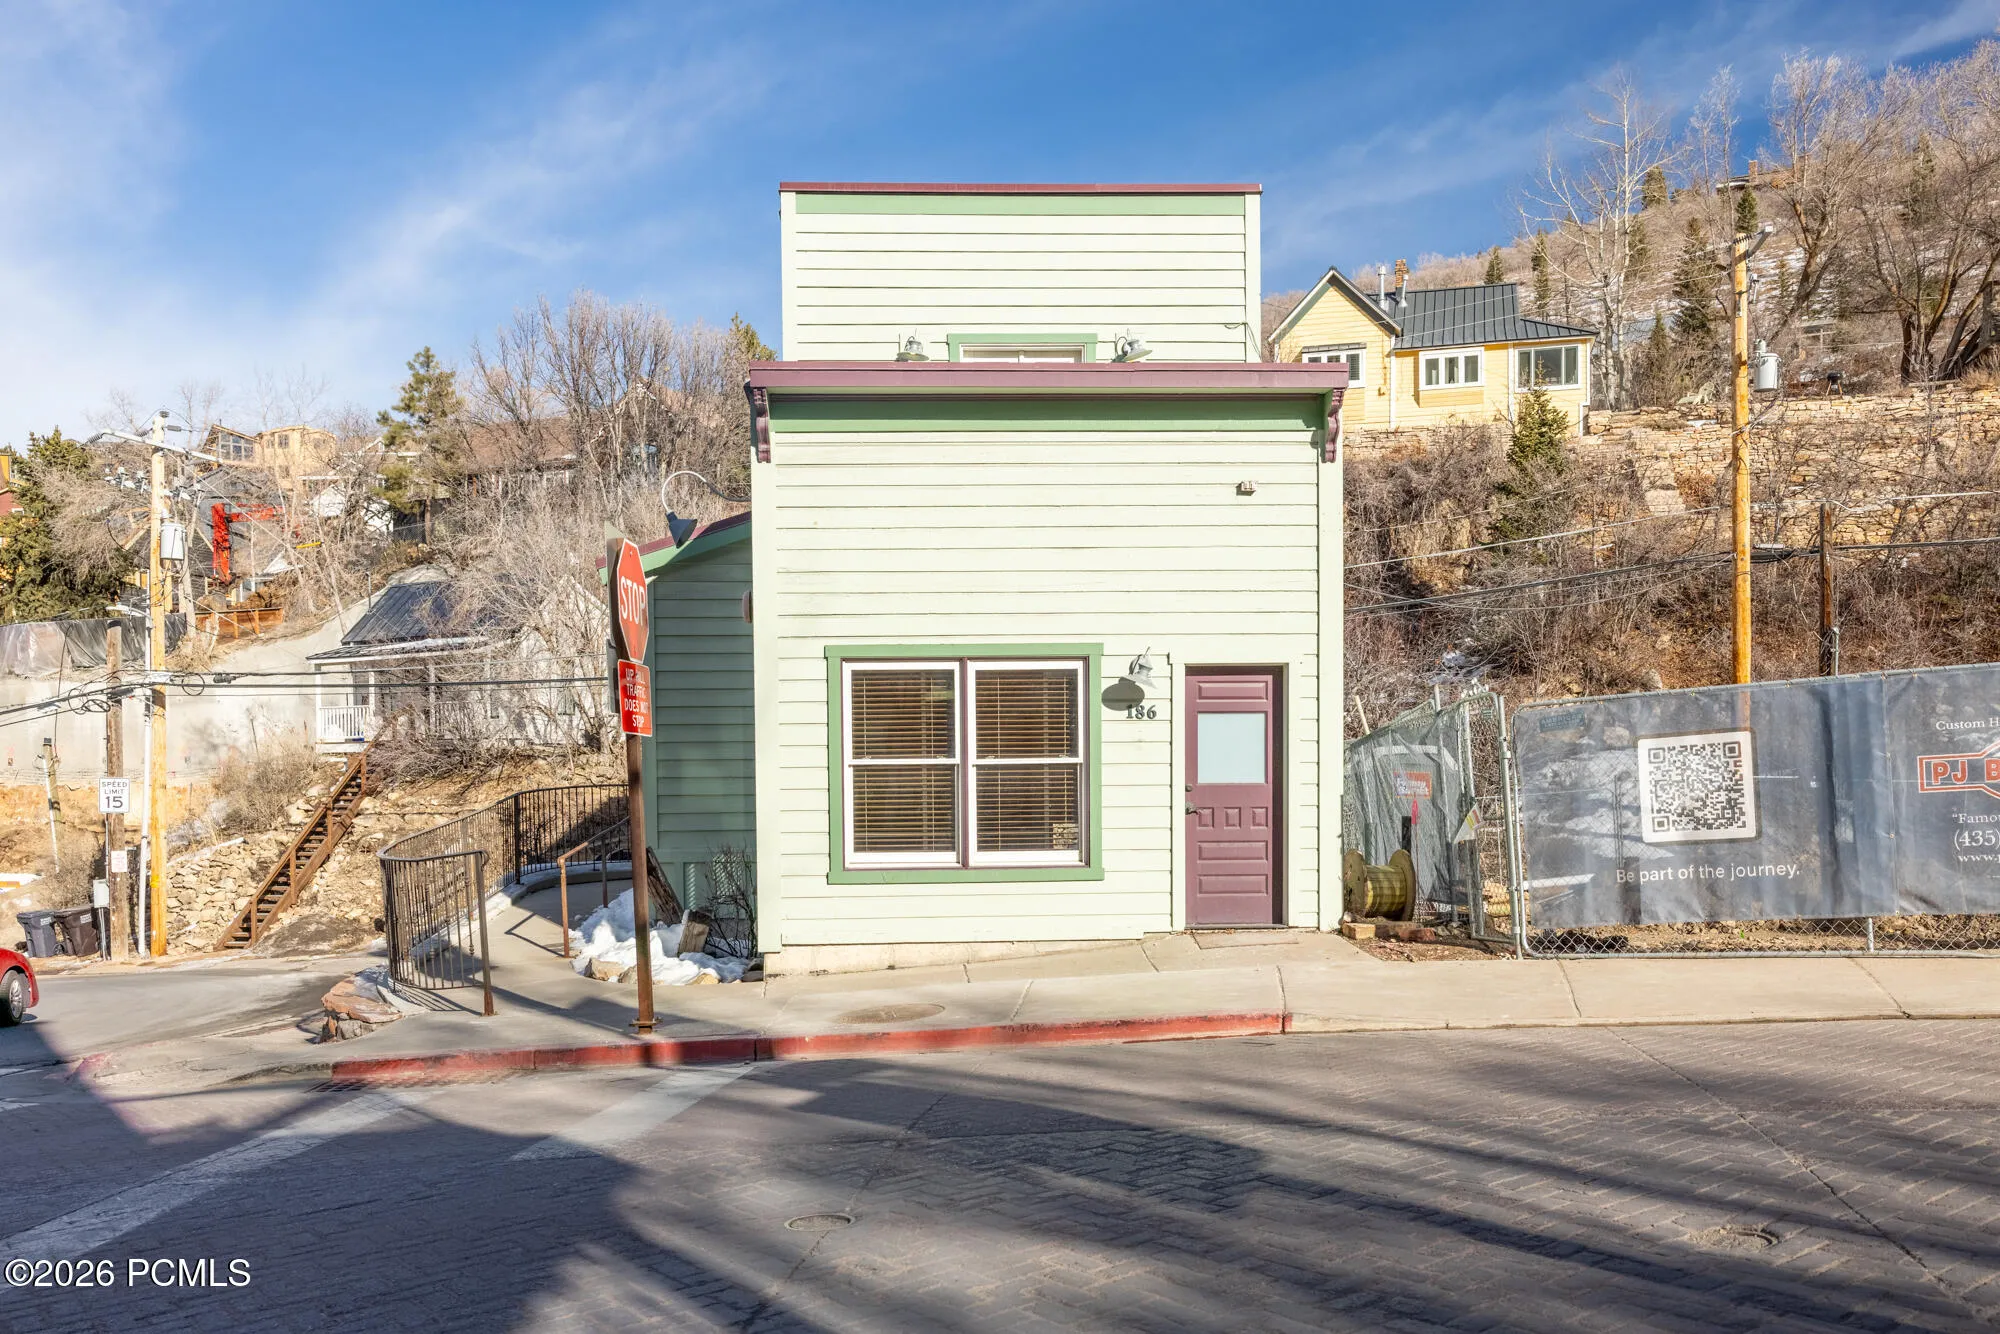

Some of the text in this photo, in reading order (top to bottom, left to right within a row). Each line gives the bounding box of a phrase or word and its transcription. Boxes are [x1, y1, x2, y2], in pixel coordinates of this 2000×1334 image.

[620, 575, 646, 626] STOP
[624, 698, 640, 713] DOES
[1126, 704, 1157, 719] 186
[1936, 720, 1985, 731] Custom
[1931, 759, 1968, 785] PJ
[105, 795, 123, 809] 15
[1954, 828, 2000, 851] (435)
[1616, 863, 1800, 885] Be part of the journey.
